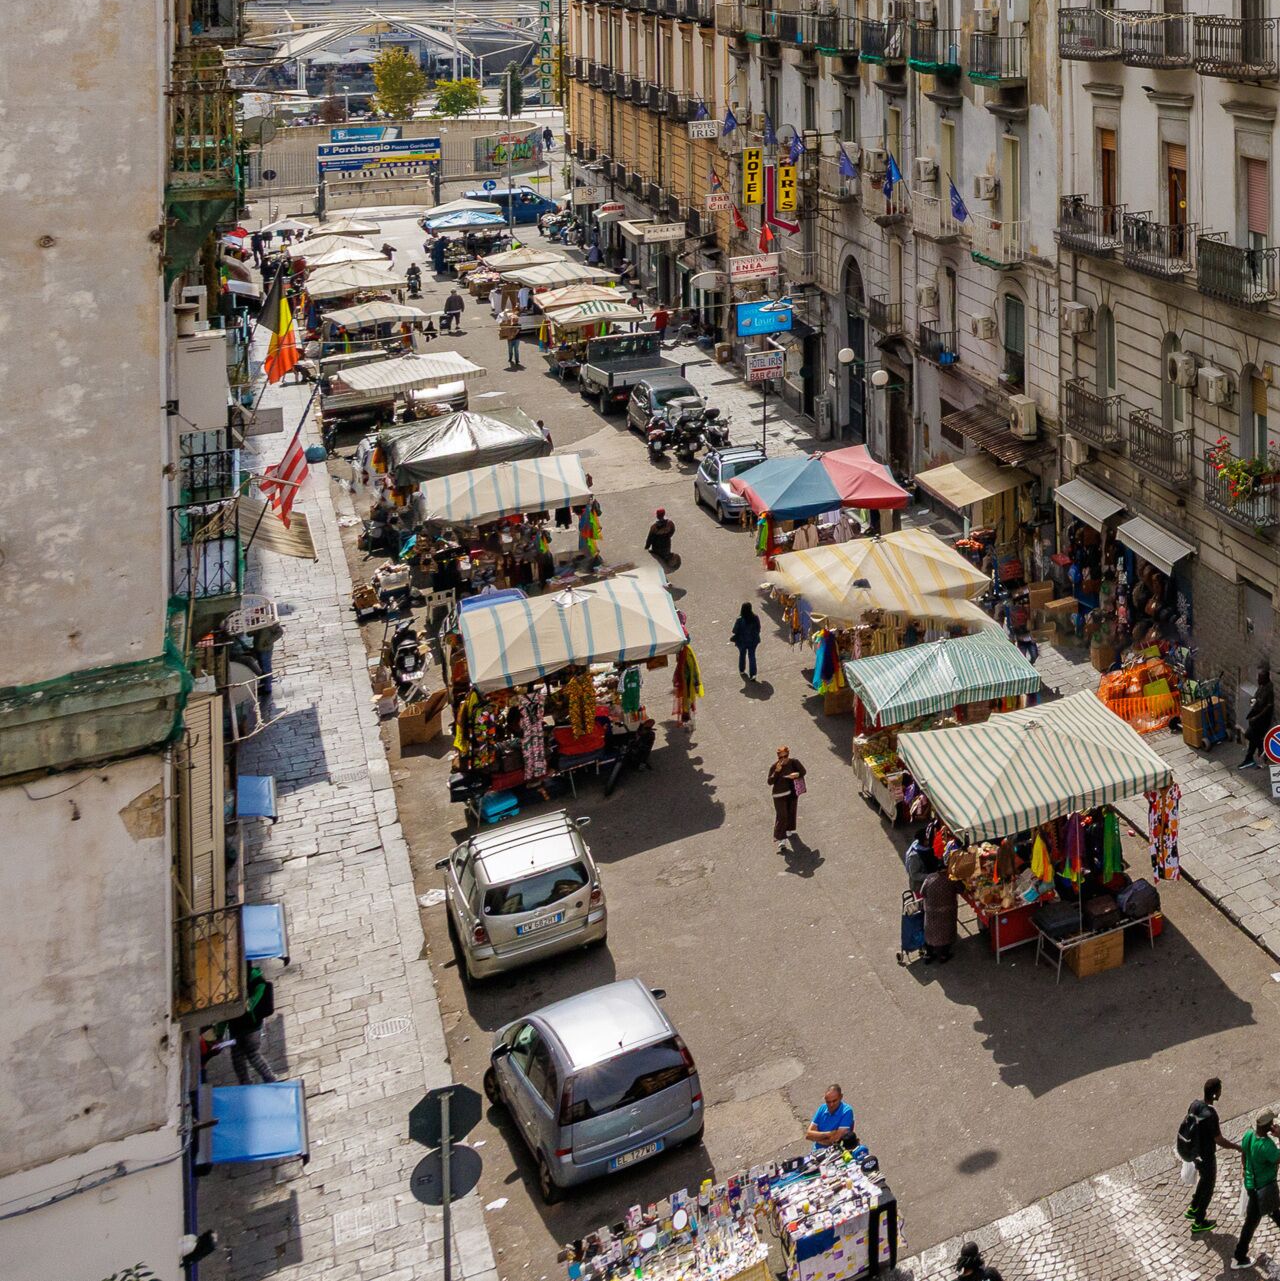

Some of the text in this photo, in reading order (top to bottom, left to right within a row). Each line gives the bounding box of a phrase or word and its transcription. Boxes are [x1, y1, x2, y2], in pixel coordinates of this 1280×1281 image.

[692, 129, 716, 138] IRIS
[332, 143, 390, 154] Parcheggio
[409, 141, 435, 149] Garibaldi
[747, 151, 759, 203] HOTEL
[781, 169, 795, 210] IRIS
[602, 204, 625, 212] MORENO
[735, 262, 763, 272] ENEA
[749, 356, 783, 368] HOTEL IRIS
[750, 372, 765, 381] B&B
